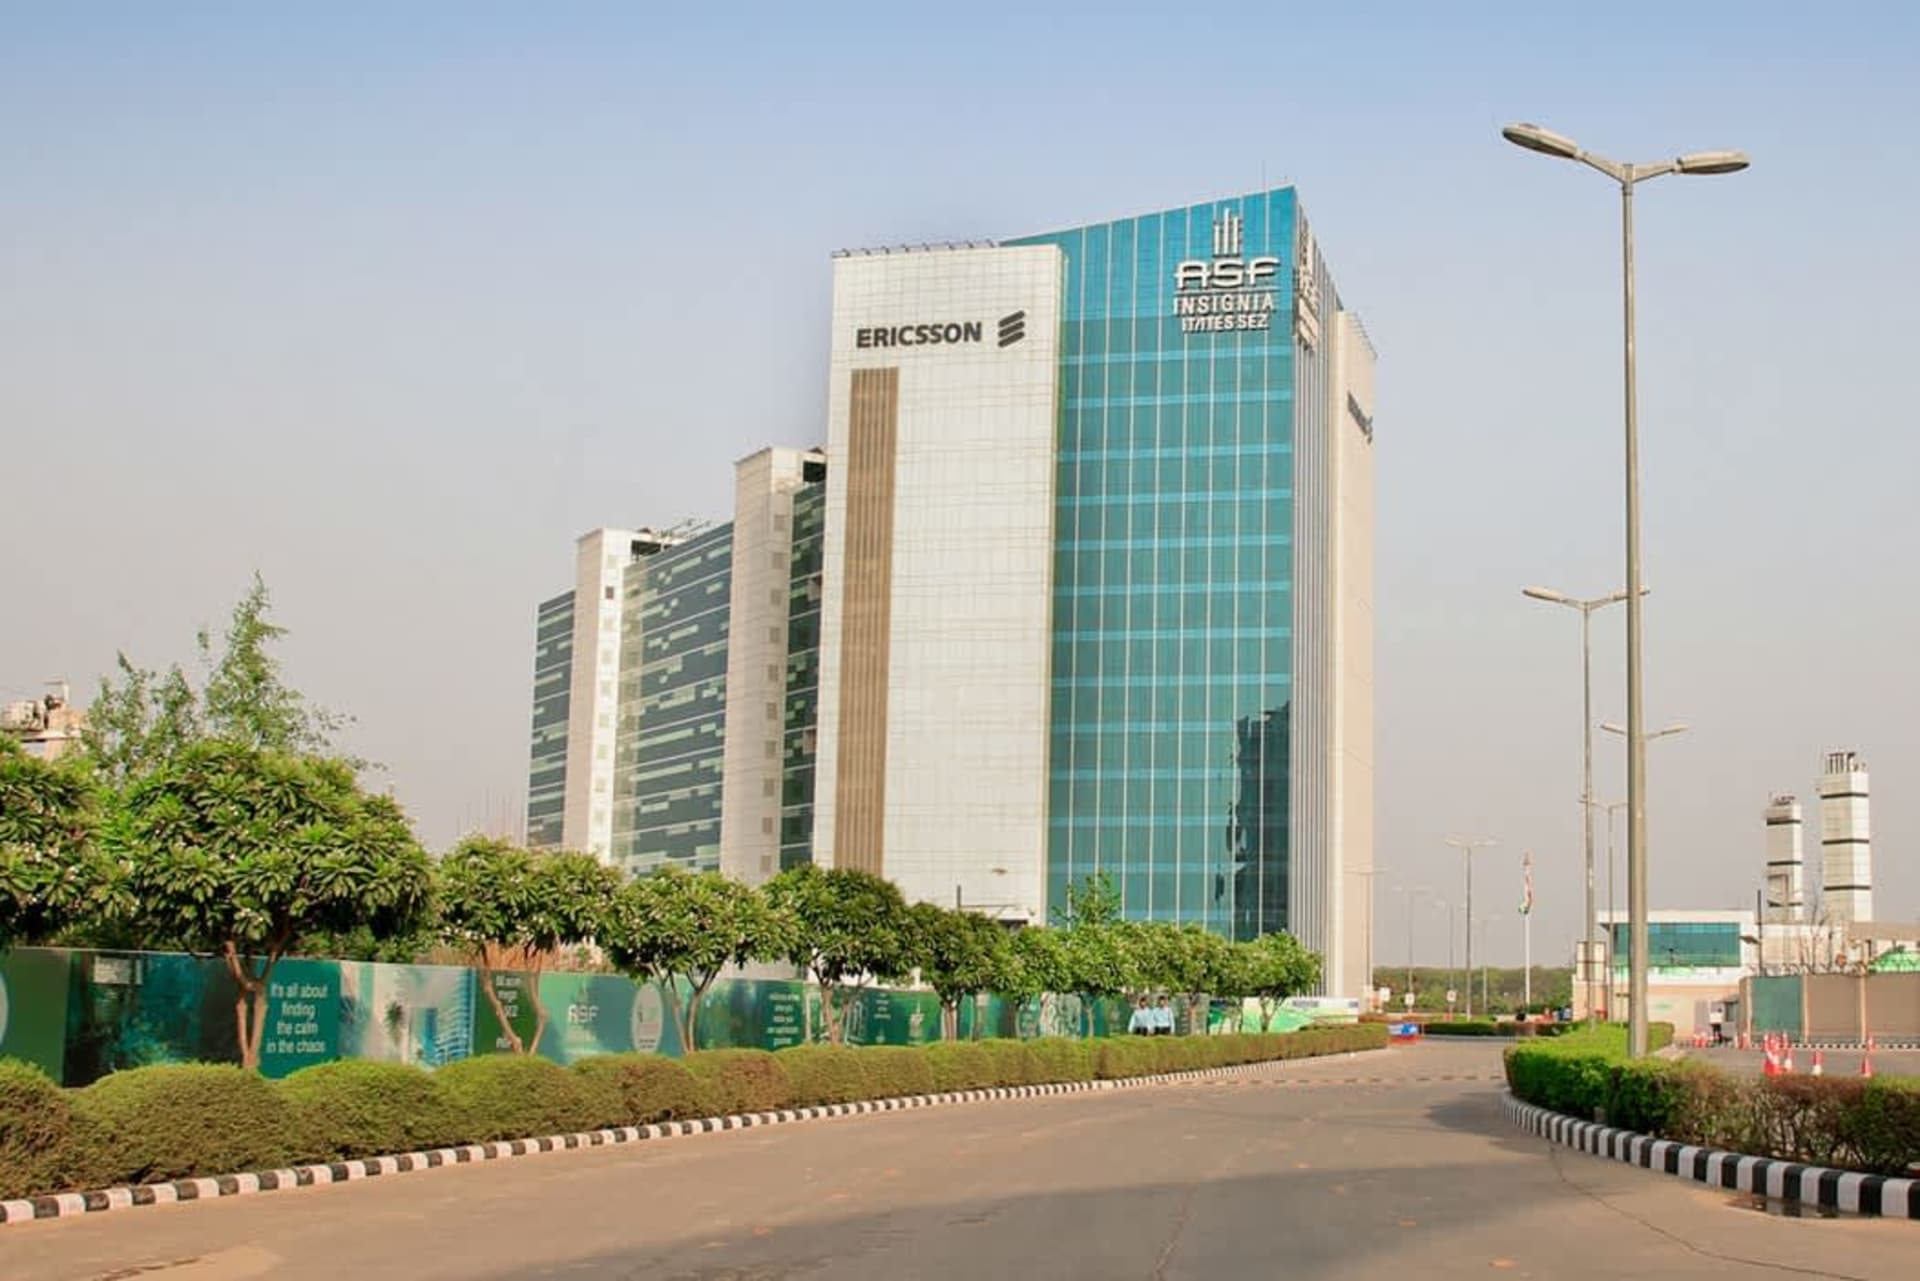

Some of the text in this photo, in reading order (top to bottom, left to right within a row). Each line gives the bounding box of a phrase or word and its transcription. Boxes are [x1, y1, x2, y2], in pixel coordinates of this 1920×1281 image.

[1173, 256, 1281, 290] ASF
[1172, 293, 1276, 316] INSIGNIA
[1237, 313, 1269, 330] SEZ
[856, 322, 982, 348] ERICSSON
[286, 983, 299, 998] all
[300, 983, 328, 998] about
[281, 1001, 316, 1020] finding
[277, 1020, 319, 1035] the calm
[266, 1039, 277, 1053] in
[278, 1039, 294, 1054] the
